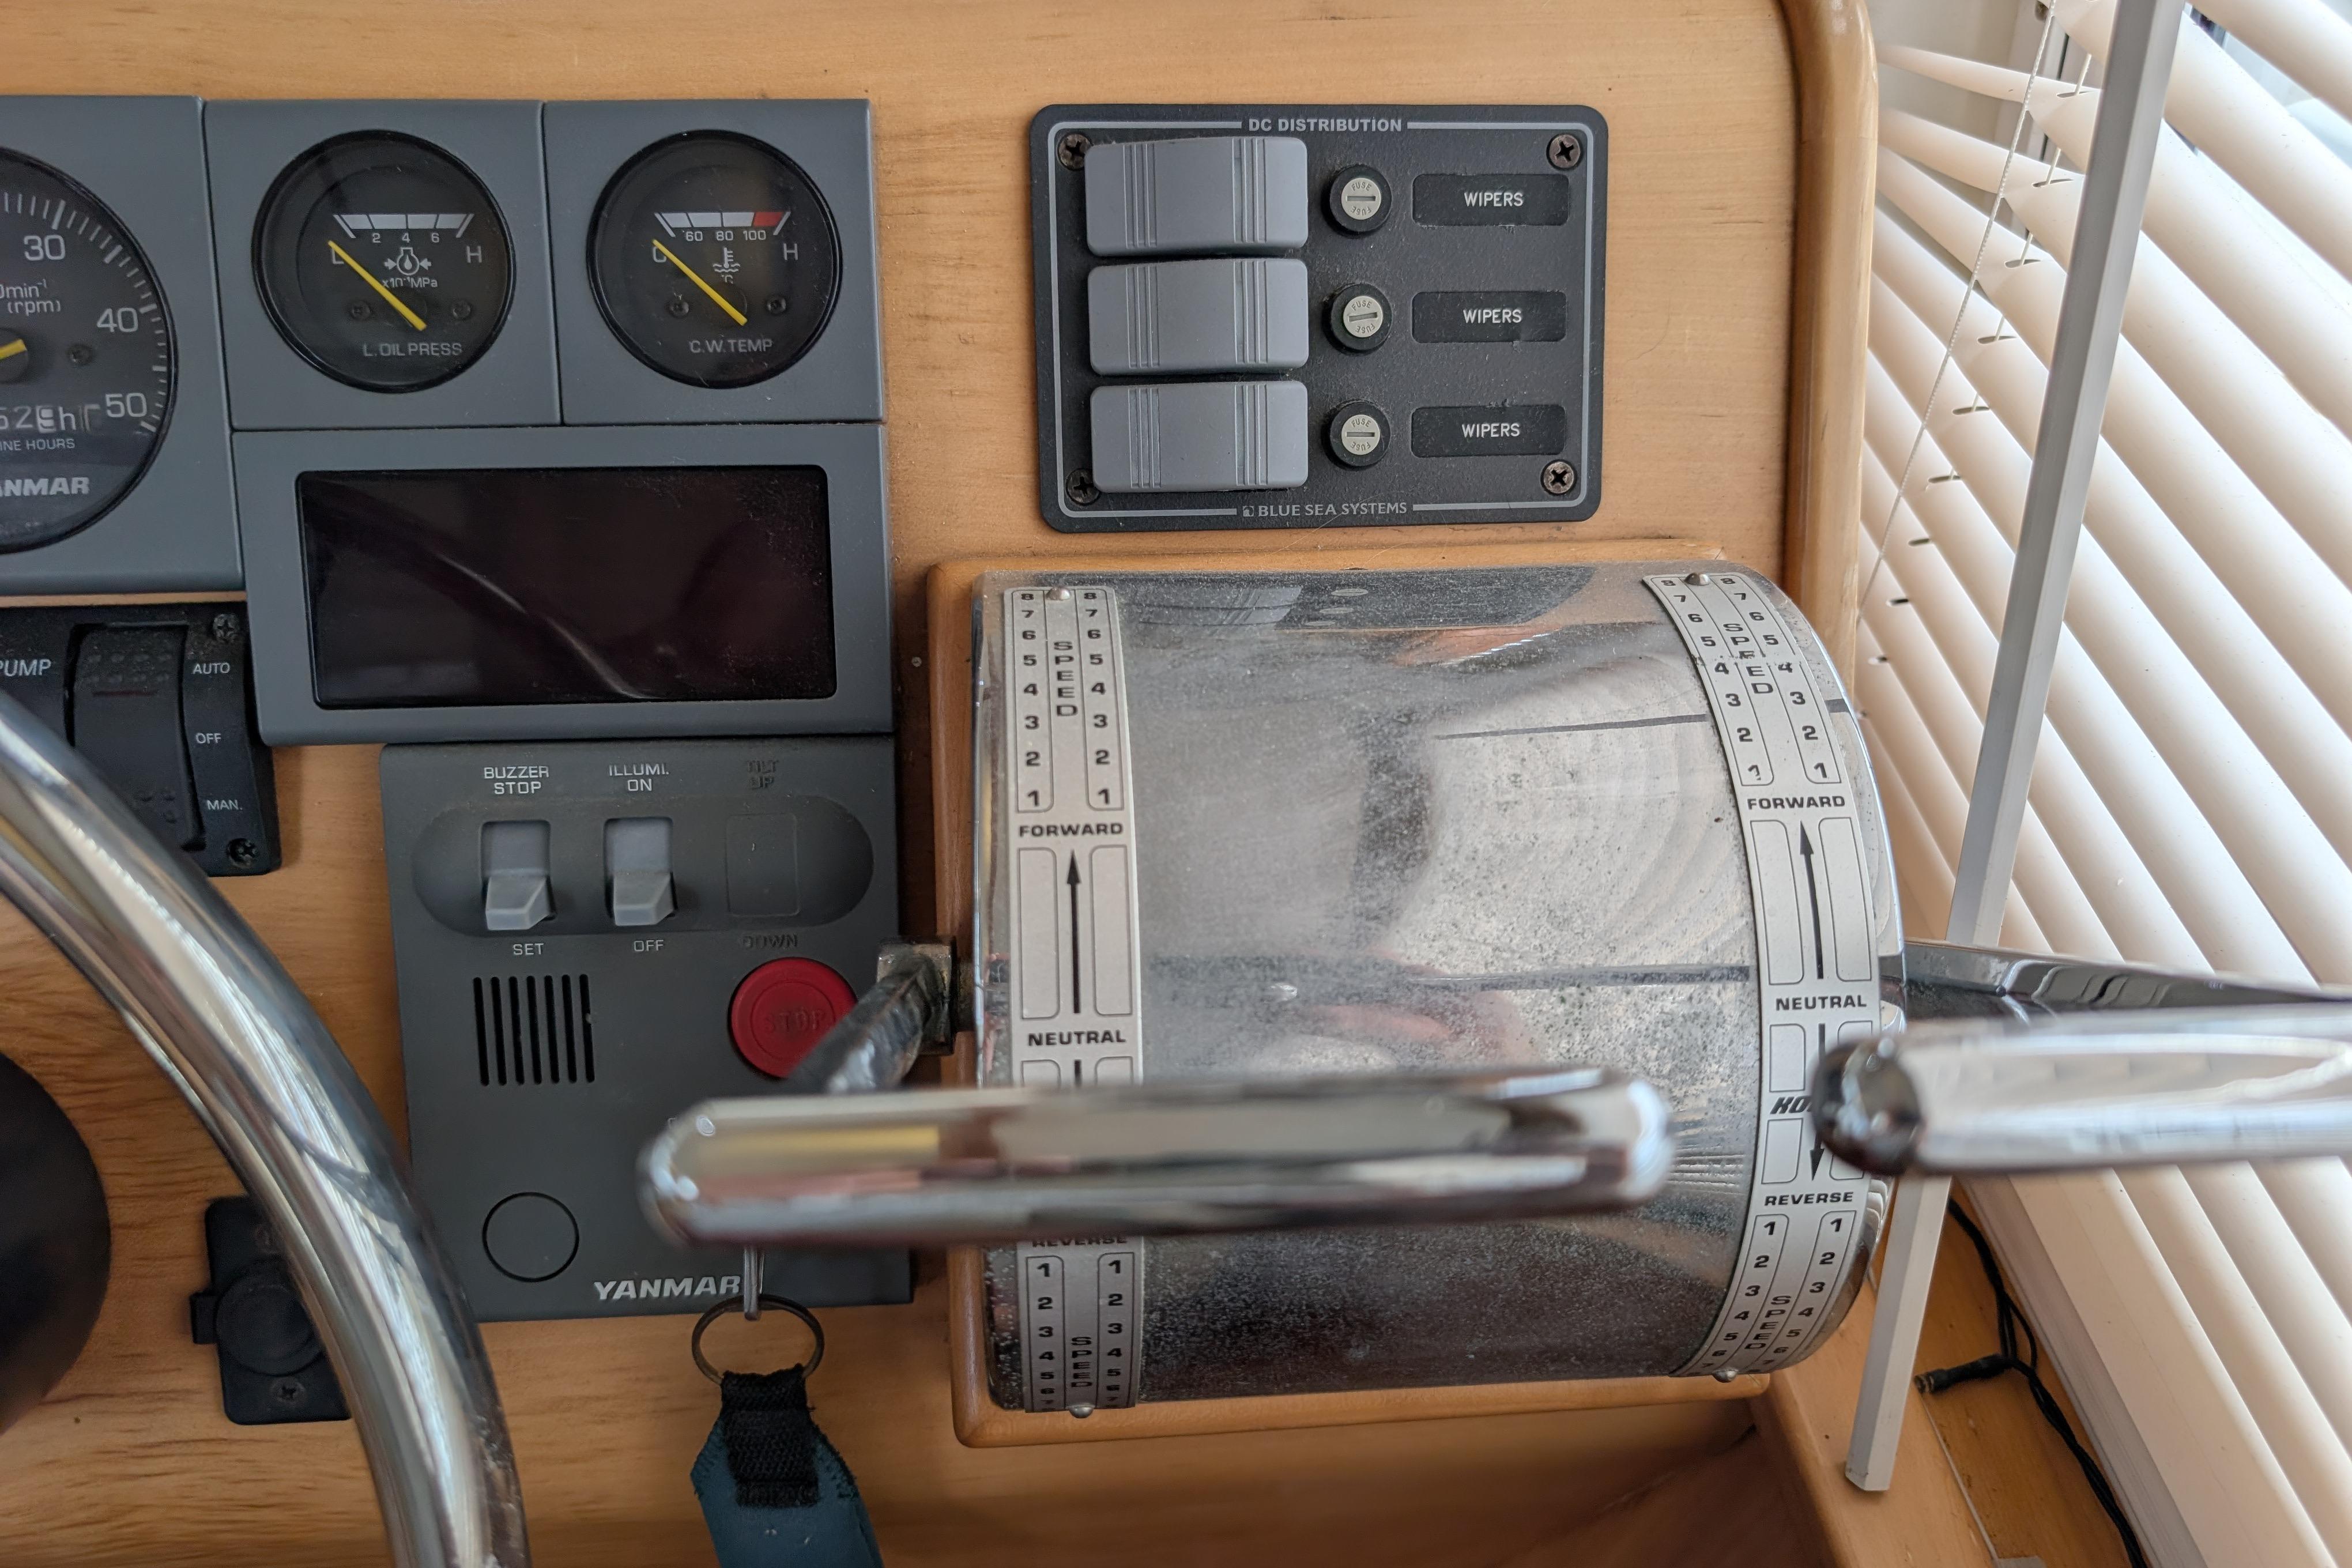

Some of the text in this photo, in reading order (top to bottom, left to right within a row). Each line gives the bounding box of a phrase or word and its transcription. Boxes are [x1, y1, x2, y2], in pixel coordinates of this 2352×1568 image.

[1249, 118, 1401, 131] DC DISTRIBUTION
[1351, 182, 1372, 191] FUSE
[1464, 191, 1524, 207] WIPERS
[1350, 206, 1371, 216] FUSE
[372, 232, 439, 243] 2 4 6
[685, 230, 766, 242] 60 80 100
[24, 235, 66, 261] 30
[466, 246, 482, 263] H
[783, 243, 798, 260] H
[7, 300, 61, 316] (rpm)
[1351, 300, 1372, 311] FUSE
[97, 307, 138, 333] 40
[1463, 308, 1522, 324] WIPERS
[1355, 323, 1375, 334] FUSE
[408, 342, 462, 356] PRESS
[105, 393, 147, 417] 50
[1351, 418, 1371, 428] FUSE
[1461, 423, 1520, 438] WIPERS
[26, 438, 75, 450] HOURS
[1350, 442, 1371, 451] FUSE
[1258, 502, 1407, 517] BLUE SEA SYSTEMS
[1734, 593, 1746, 601] 7
[1021, 609, 1098, 619] 7 7
[1687, 612, 1765, 623] 6 6
[1022, 629, 1101, 640] 6 6
[1700, 635, 1778, 647] 5 5
[1023, 654, 1103, 666] 5 5
[1722, 623, 1774, 694] SPEED
[192, 662, 231, 674] AUTO
[1714, 662, 1793, 675] 4 4
[1053, 641, 1078, 717] SPEED
[1023, 682, 1106, 696] 4 4
[1725, 692, 1806, 707] 3 3
[1025, 714, 1108, 730] 3 3
[195, 733, 221, 744] OFF
[1737, 725, 1818, 742] 2 2
[1026, 750, 1110, 767] 2 2
[483, 765, 549, 779] BUZZER
[609, 763, 669, 776] ILLUMI.
[1748, 763, 1827, 781] 1 1
[494, 781, 541, 794] STOP
[627, 778, 653, 791] ON
[1027, 788, 1110, 806] 1 1
[1747, 796, 1845, 810] FORWARD
[206, 800, 243, 811] MAN.
[1019, 823, 1124, 838] FORWARD
[512, 943, 544, 955] SET
[634, 939, 664, 952] OFF
[1776, 994, 1867, 1011] NEUTRAL
[1028, 1029, 1126, 1046] NEUTRAL
[1765, 1192, 1853, 1206] REVERSE
[1763, 1218, 1842, 1235] 1 1
[1754, 1252, 1835, 1268] 2 2
[1038, 1260, 1121, 1277] 1 1
[594, 1275, 741, 1300] YANMAR
[1745, 1281, 1825, 1296] 3 3
[1038, 1294, 1123, 1310] 2 2
[1734, 1307, 1814, 1320] 4 4
[1744, 1295, 1791, 1349] SPEED
[1038, 1323, 1122, 1337] 3 3
[1723, 1329, 1801, 1341] 5 5
[1039, 1348, 1122, 1360] 4 4
[1071, 1336, 1092, 1388] SPEED
